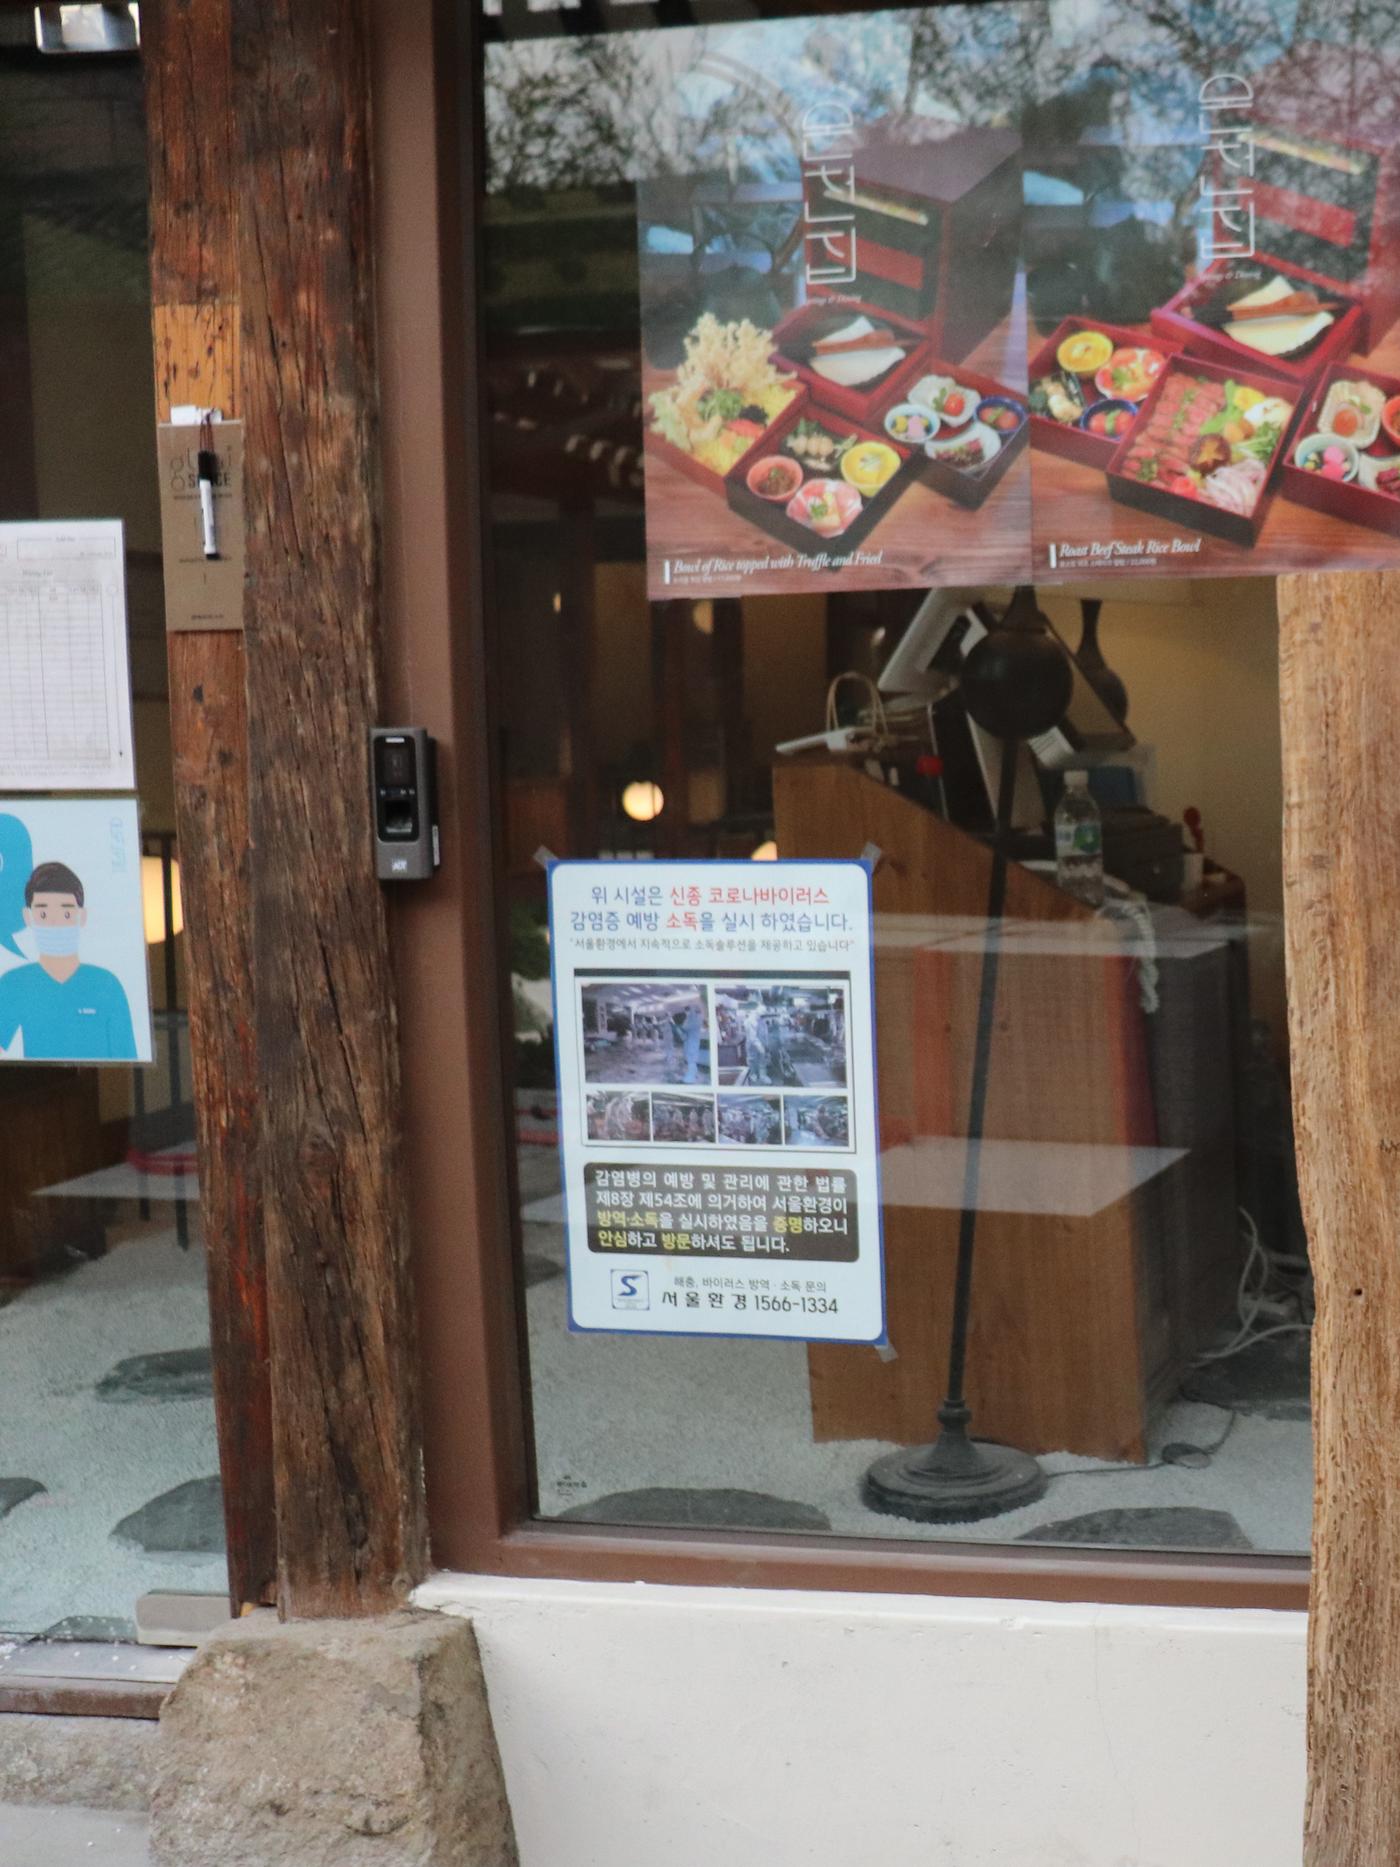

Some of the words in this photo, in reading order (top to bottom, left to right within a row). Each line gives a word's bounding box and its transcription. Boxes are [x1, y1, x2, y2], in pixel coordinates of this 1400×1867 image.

[1198, 73, 1254, 260] 온천집
[802, 102, 856, 285] 온천집
[1059, 543, 1088, 557] Roast
[1090, 541, 1114, 559] Beef
[1114, 540, 1144, 555] Steak
[1146, 539, 1170, 554] Rice
[1172, 538, 1202, 554] Bowl
[674, 559, 700, 574] Bowl
[701, 559, 713, 576] of
[714, 558, 734, 573] Rice
[736, 556, 769, 576] topped
[769, 554, 795, 570] with
[797, 552, 831, 572] Truffle
[832, 553, 851, 566] and
[851, 550, 883, 565] Fried
[591, 886, 607, 905] 위
[615, 886, 664, 905] 시설은
[670, 887, 702, 906] 신종
[708, 886, 830, 905] 코로나바이러스
[570, 911, 620, 932] 감염증
[626, 912, 660, 931] 예방
[666, 912, 716, 932] 소독을
[722, 912, 755, 932] 실시
[760, 912, 853, 932] 하였습니다.
[640, 938, 690, 951] 지속적으로
[695, 938, 757, 952] 소독솔루션을
[761, 939, 802, 953] 제공하고
[596, 1169, 657, 1189] 감염병의
[663, 1172, 694, 1189] 예방
[702, 1173, 716, 1190] 및
[723, 1173, 770, 1192] 관리에
[776, 1175, 808, 1193] 관한
[816, 1176, 847, 1194] 법률
[596, 1191, 634, 1208] 제8장
[639, 1192, 702, 1210] 제54조에
[708, 1194, 768, 1212] 의거하여
[772, 1196, 847, 1215] 서울환경이
[598, 1211, 674, 1230] 방역·소독을
[679, 1213, 768, 1233] 실시하였음을
[773, 1217, 848, 1235] 증명하오니
[598, 1231, 657, 1249] 안심하고
[661, 1233, 737, 1251] 방문하셔도
[742, 1235, 790, 1253] 됩니다.
[674, 1276, 699, 1289] 해충,
[702, 1277, 745, 1290] 바이러스
[749, 1279, 770, 1291] 방역
[780, 1280, 802, 1292] 소독
[805, 1281, 827, 1293] 문의
[755, 1295, 839, 1314] 1566-1334
